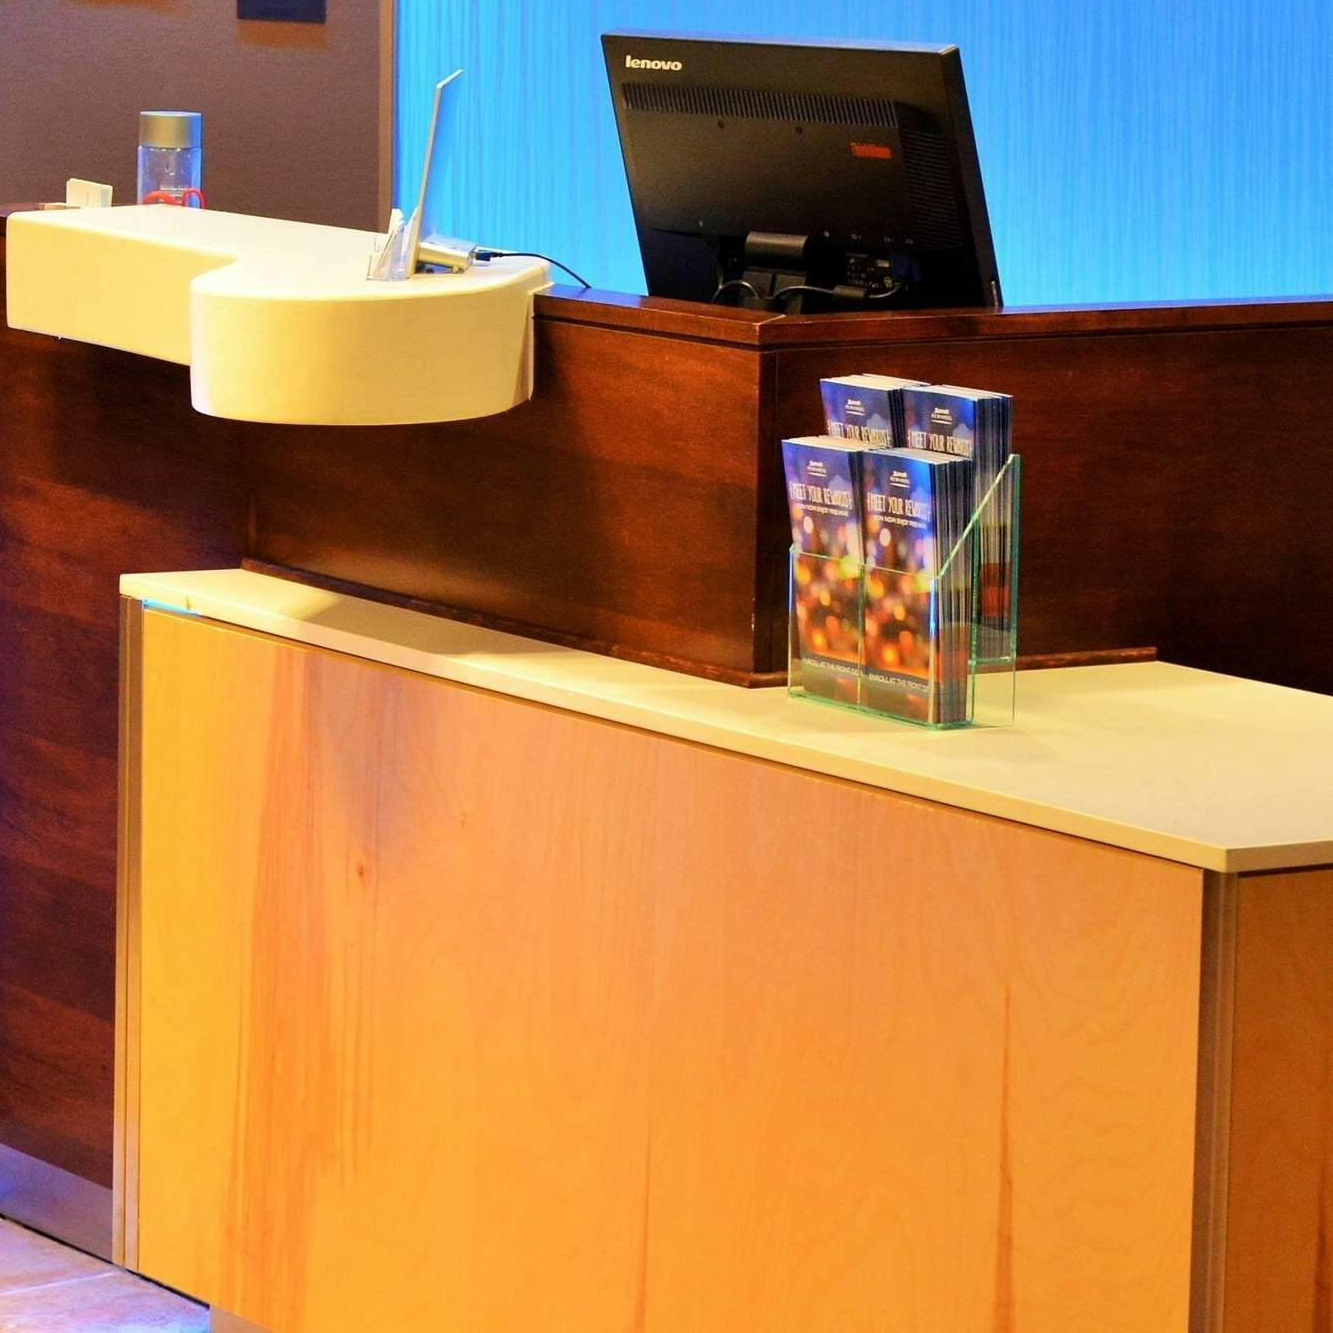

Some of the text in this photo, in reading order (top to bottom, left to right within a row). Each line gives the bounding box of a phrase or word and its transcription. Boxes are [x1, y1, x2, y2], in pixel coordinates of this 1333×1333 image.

[625, 54, 683, 71] lenovo
[806, 485, 823, 504] YOUR
[886, 496, 904, 516] YOUR
